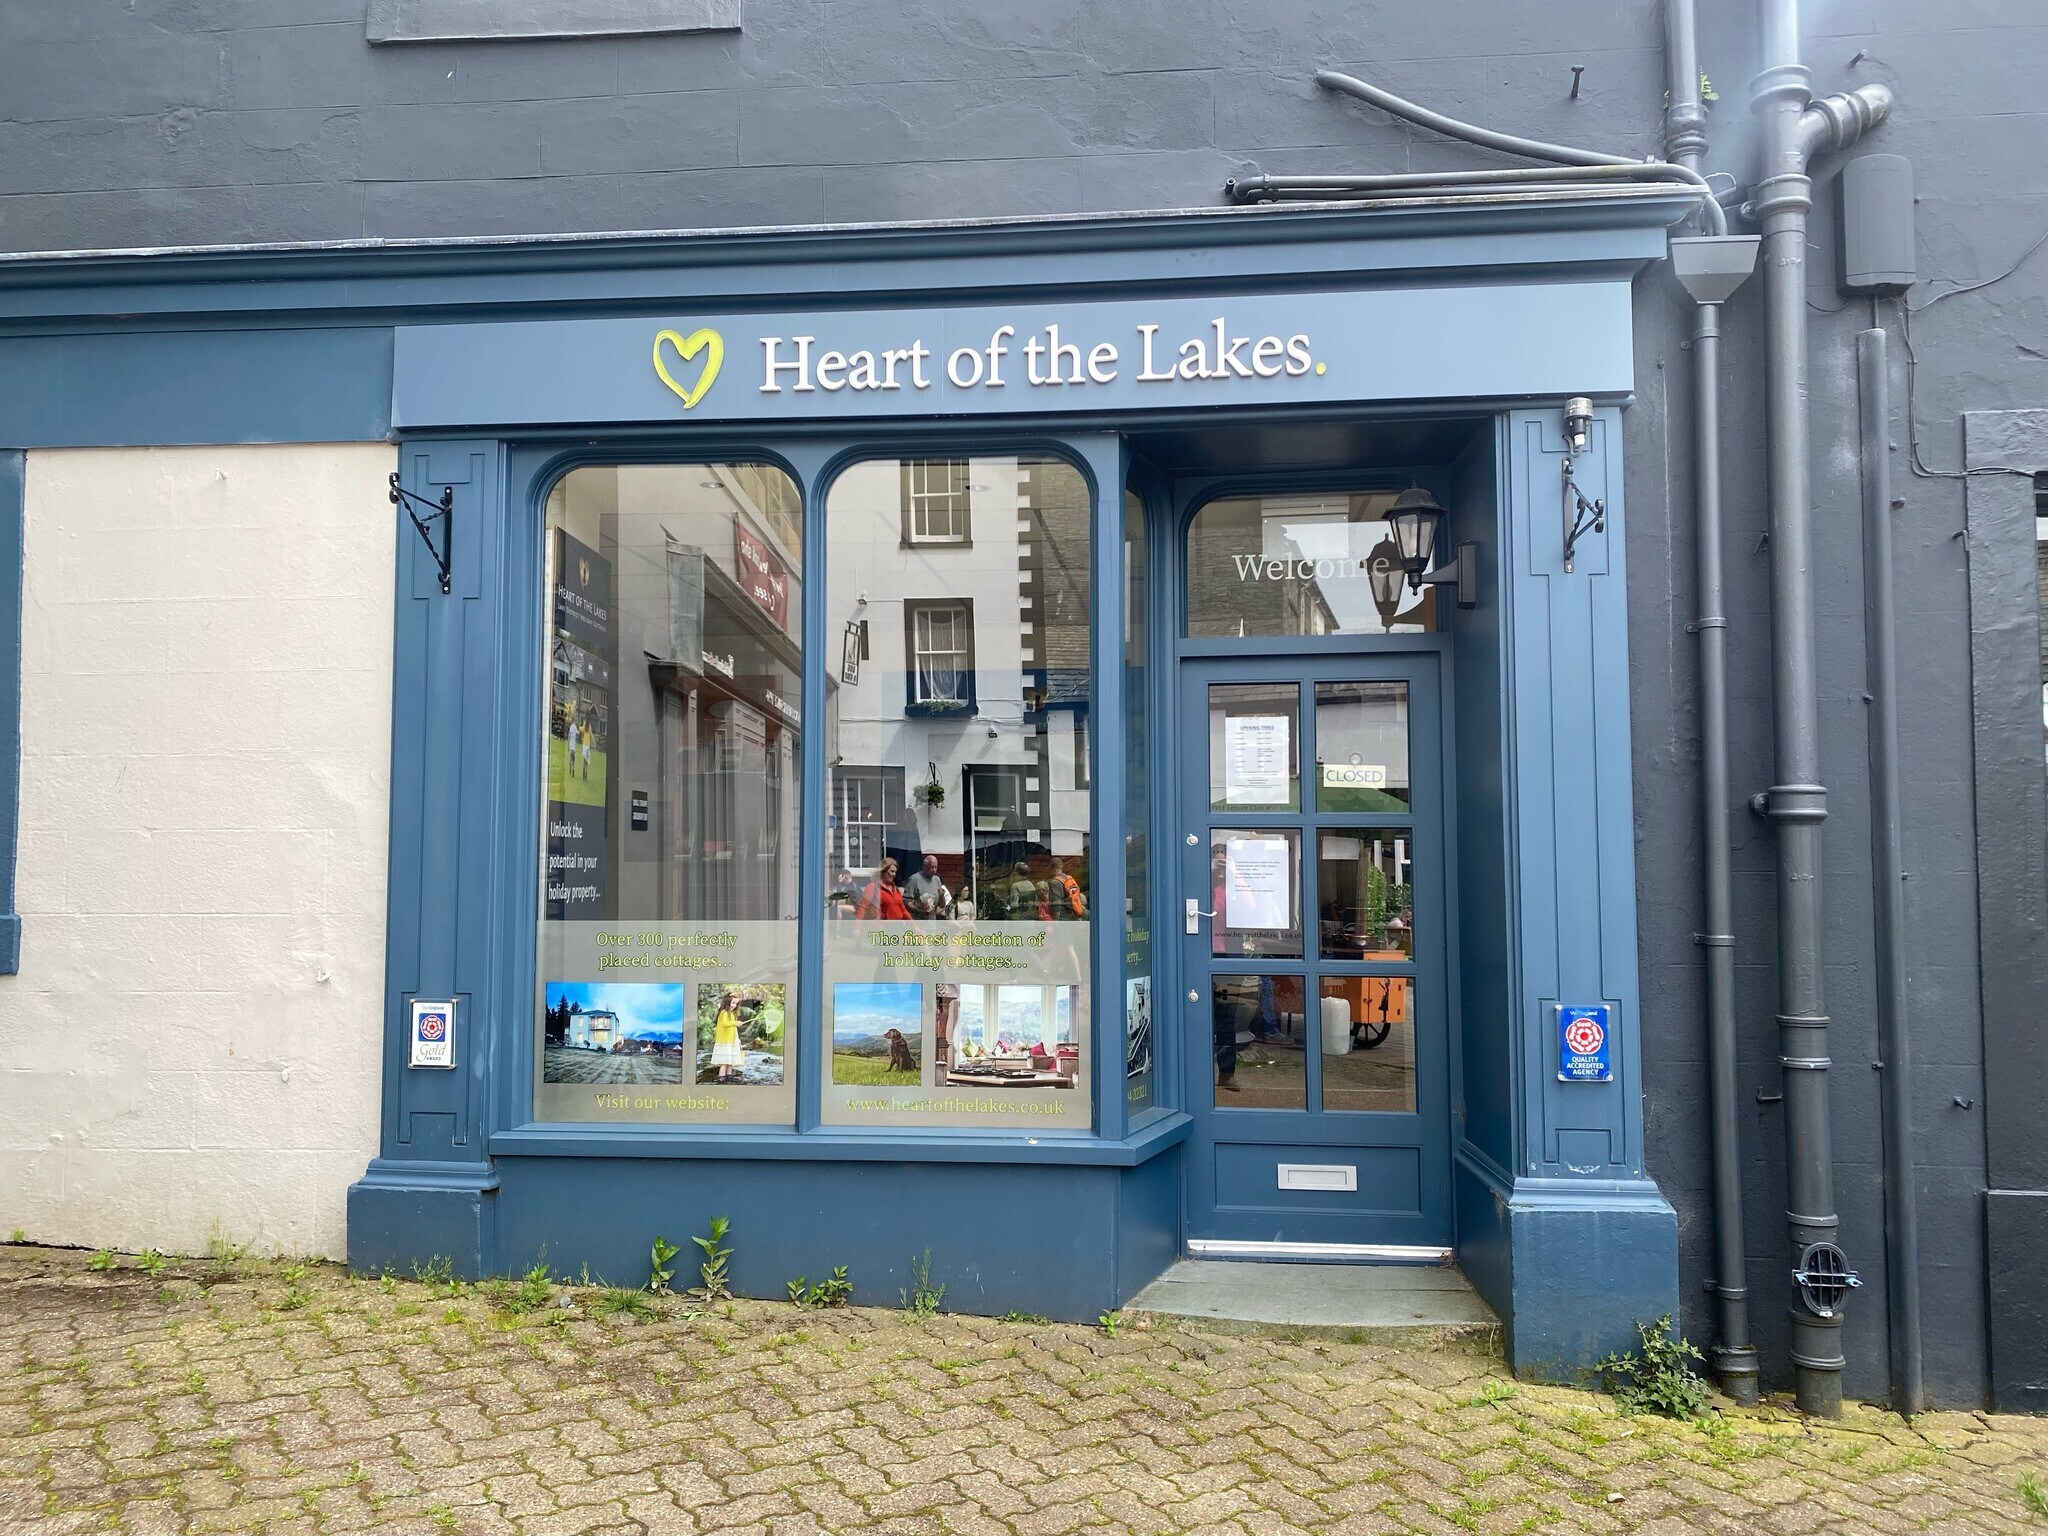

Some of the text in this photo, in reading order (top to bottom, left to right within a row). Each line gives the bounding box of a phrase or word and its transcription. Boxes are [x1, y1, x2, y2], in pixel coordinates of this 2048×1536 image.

[759, 316, 1327, 394] Heart of the Lakes.
[1232, 552, 1390, 581] Welcome
[1326, 769, 1383, 783] CLOSED
[550, 820, 583, 839] Unlock the
[549, 852, 598, 873] potential in your
[548, 882, 571, 904] holiday
[596, 932, 738, 950] Over 300 perfectly
[869, 931, 1046, 946] The finest selection of
[599, 953, 734, 971] placed cottages...
[884, 953, 1028, 971] holiday cottages...
[416, 1043, 447, 1062] Gold
[595, 1094, 730, 1110] Visit our website:
[846, 1098, 1065, 1114] www.heartofthelakes.co.uk
